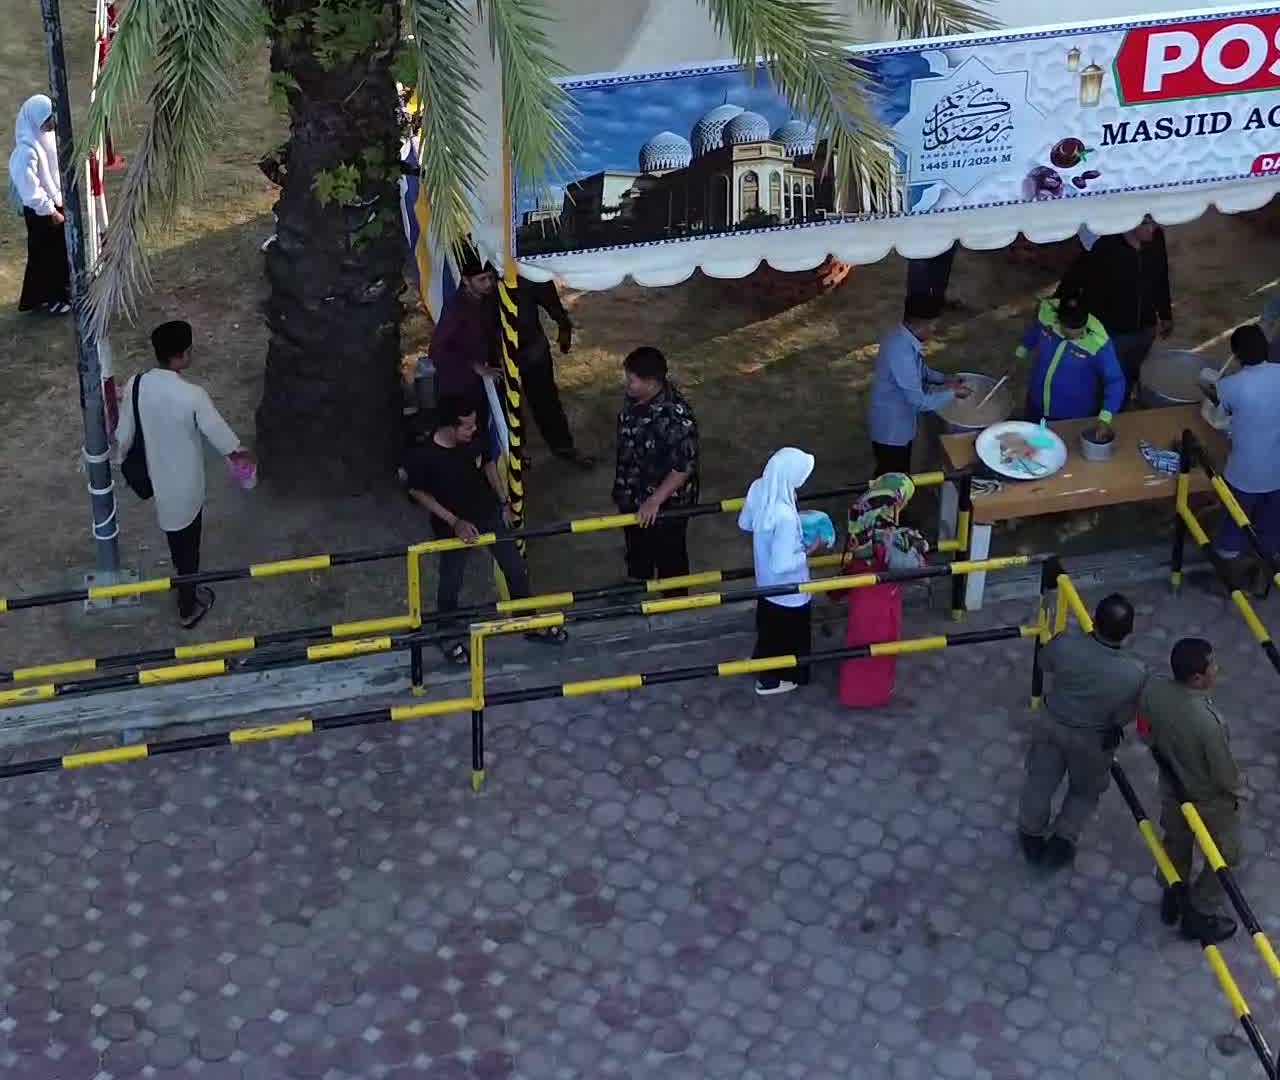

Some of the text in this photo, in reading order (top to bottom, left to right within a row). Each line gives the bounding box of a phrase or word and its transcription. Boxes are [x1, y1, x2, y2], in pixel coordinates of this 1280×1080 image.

[1100, 111, 1232, 146] MASJID
[920, 153, 1012, 172] 1445 H/2024 M
